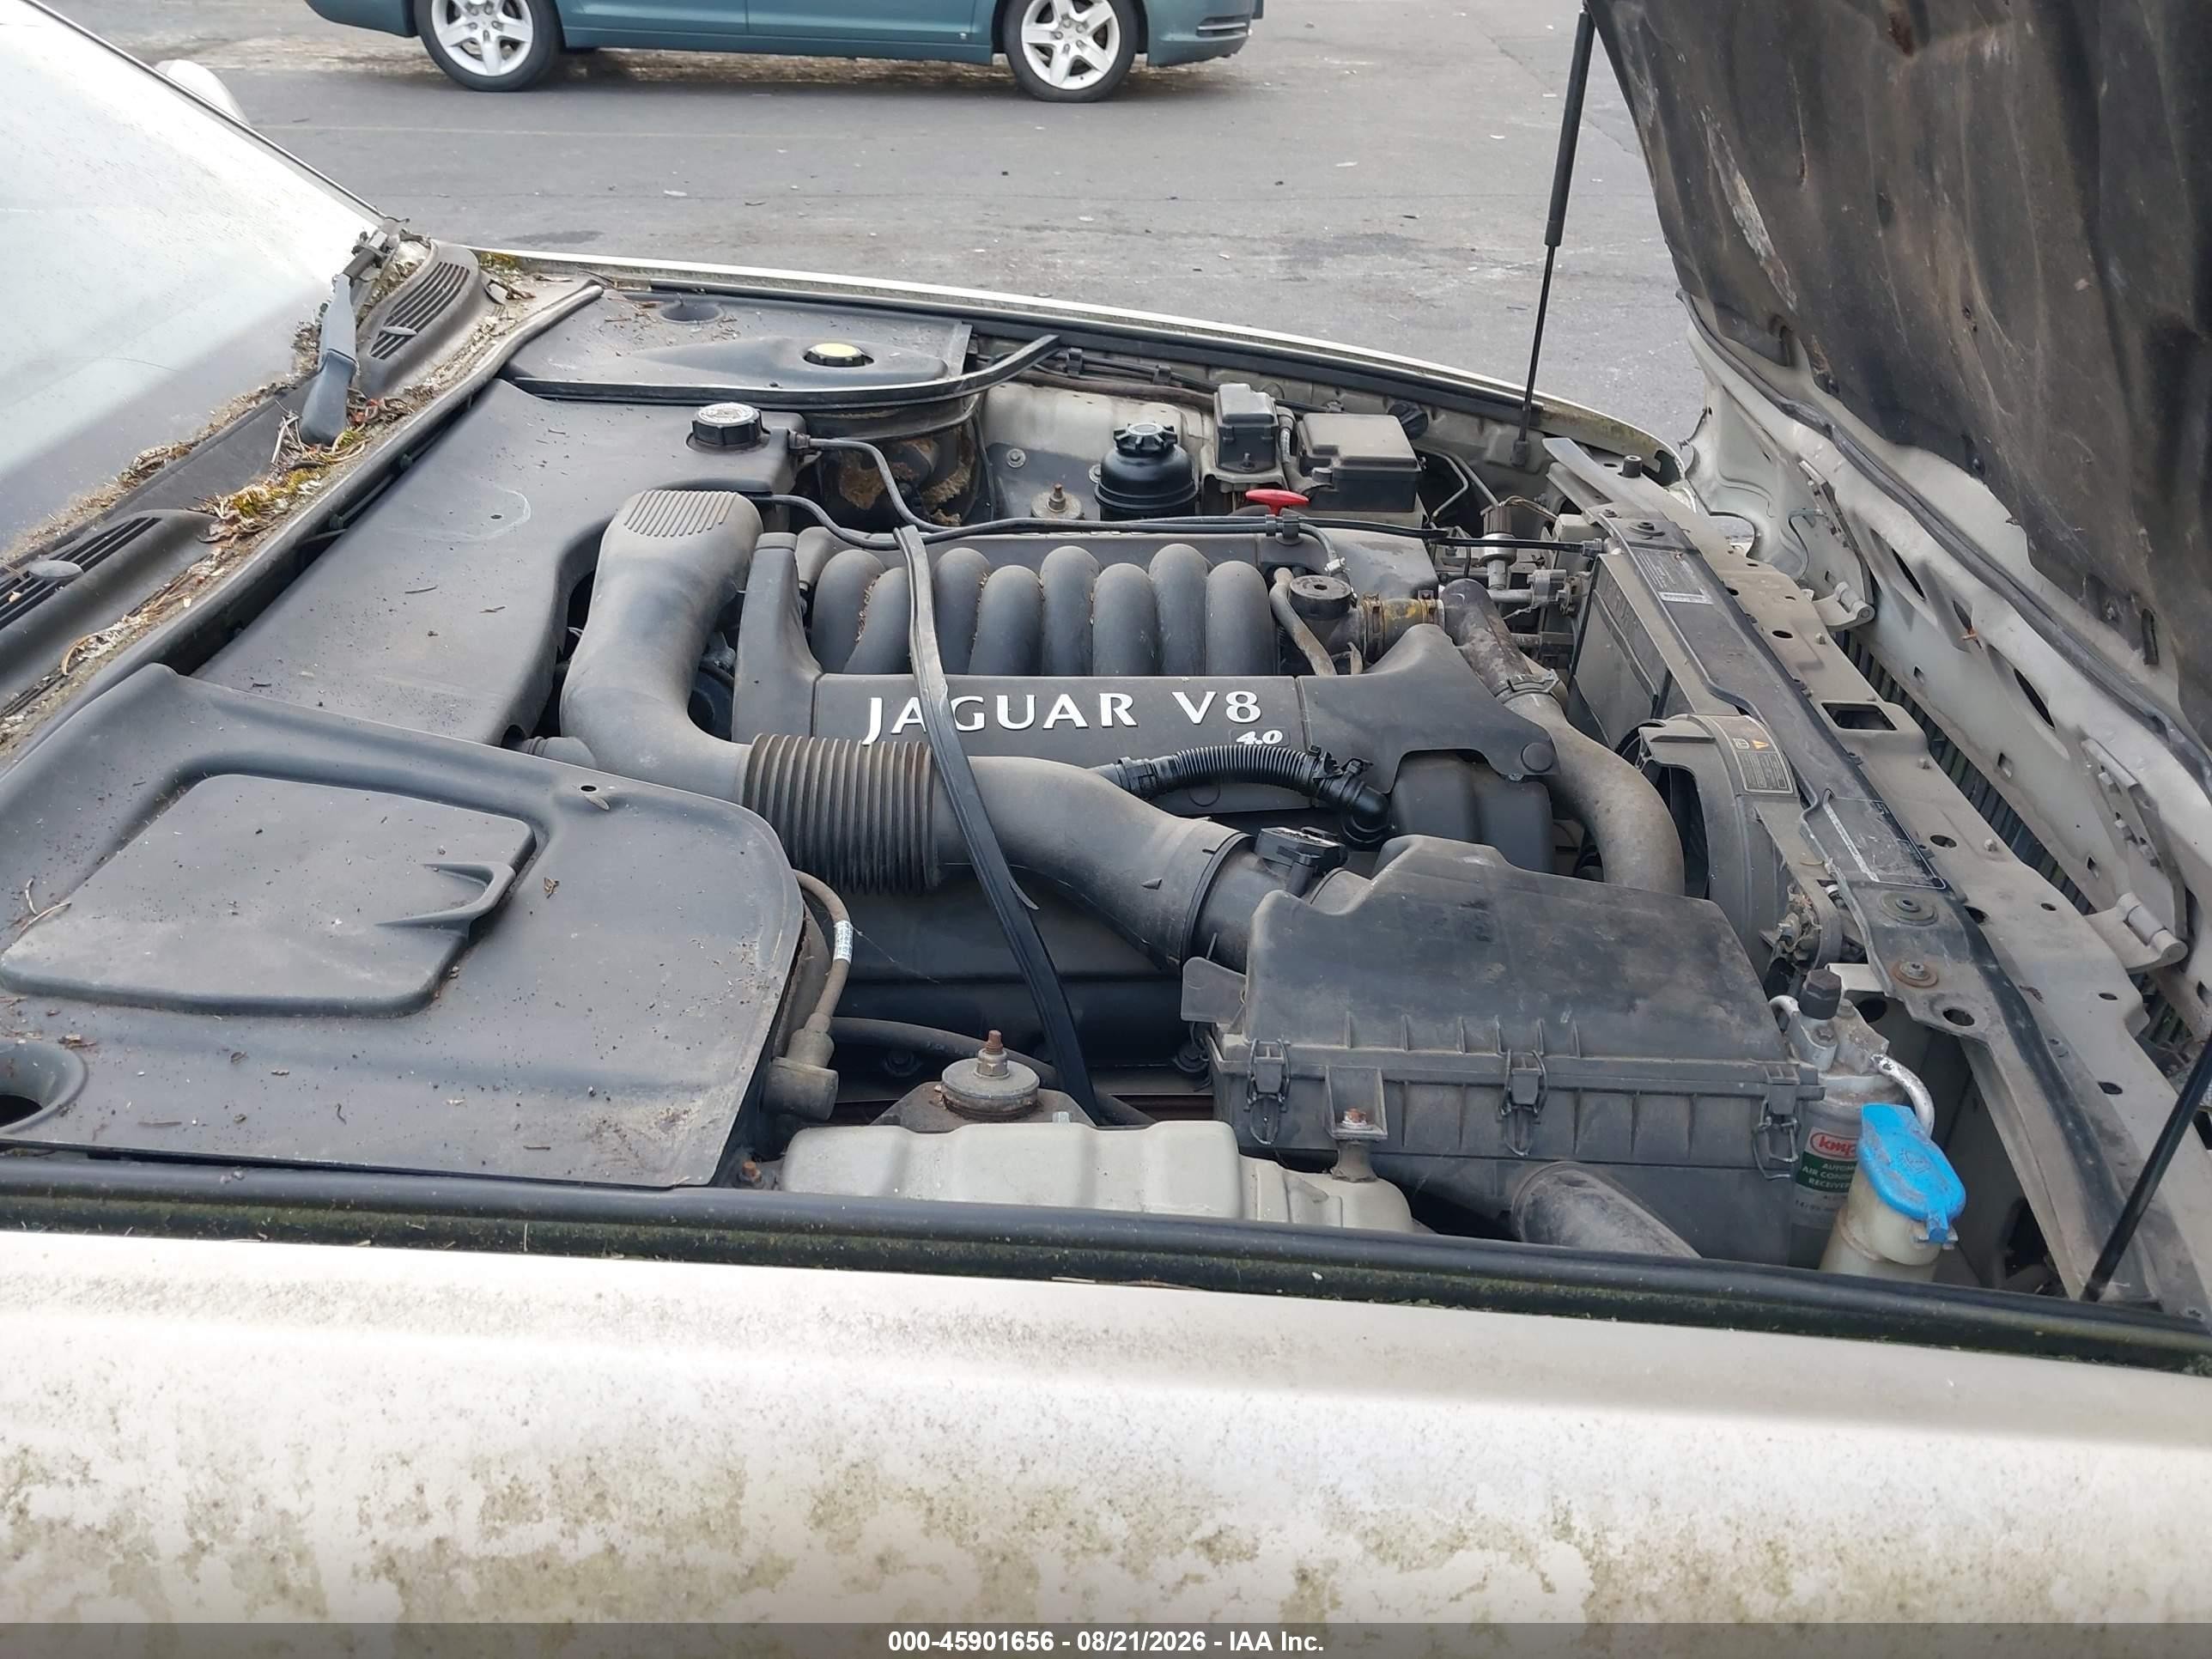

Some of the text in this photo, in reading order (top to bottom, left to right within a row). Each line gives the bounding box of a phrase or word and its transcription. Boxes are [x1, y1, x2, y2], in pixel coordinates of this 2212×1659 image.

[862, 691, 1262, 745] JAGUAR V8
[1236, 730, 1284, 746] 4.0
[1802, 1165, 1819, 1176] AIR
